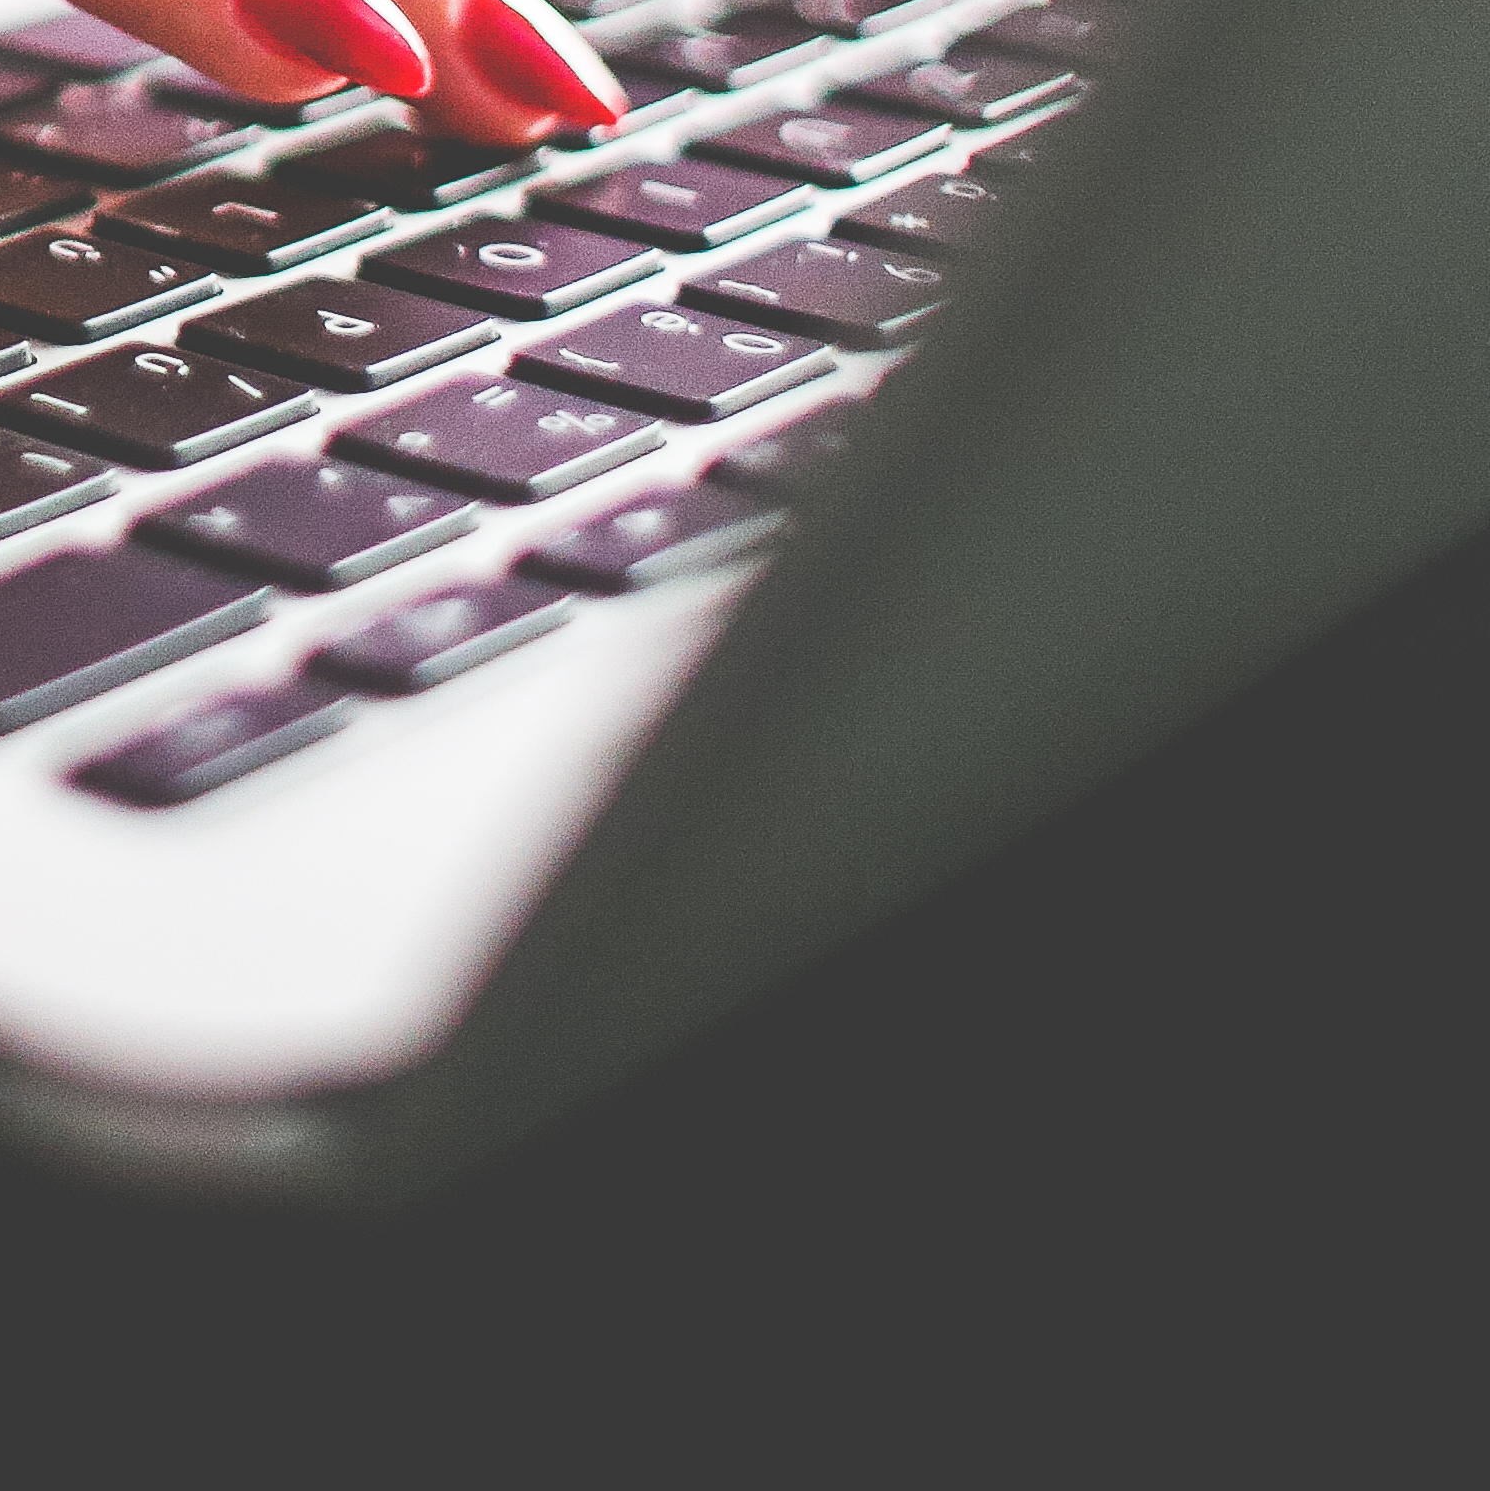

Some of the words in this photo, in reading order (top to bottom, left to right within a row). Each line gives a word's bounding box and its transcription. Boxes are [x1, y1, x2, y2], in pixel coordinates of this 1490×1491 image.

[211, 200, 281, 227] L
[477, 242, 547, 269] O
[882, 262, 943, 283] 9
[316, 309, 380, 338] P
[639, 309, 702, 336] é
[537, 410, 618, 436] %
